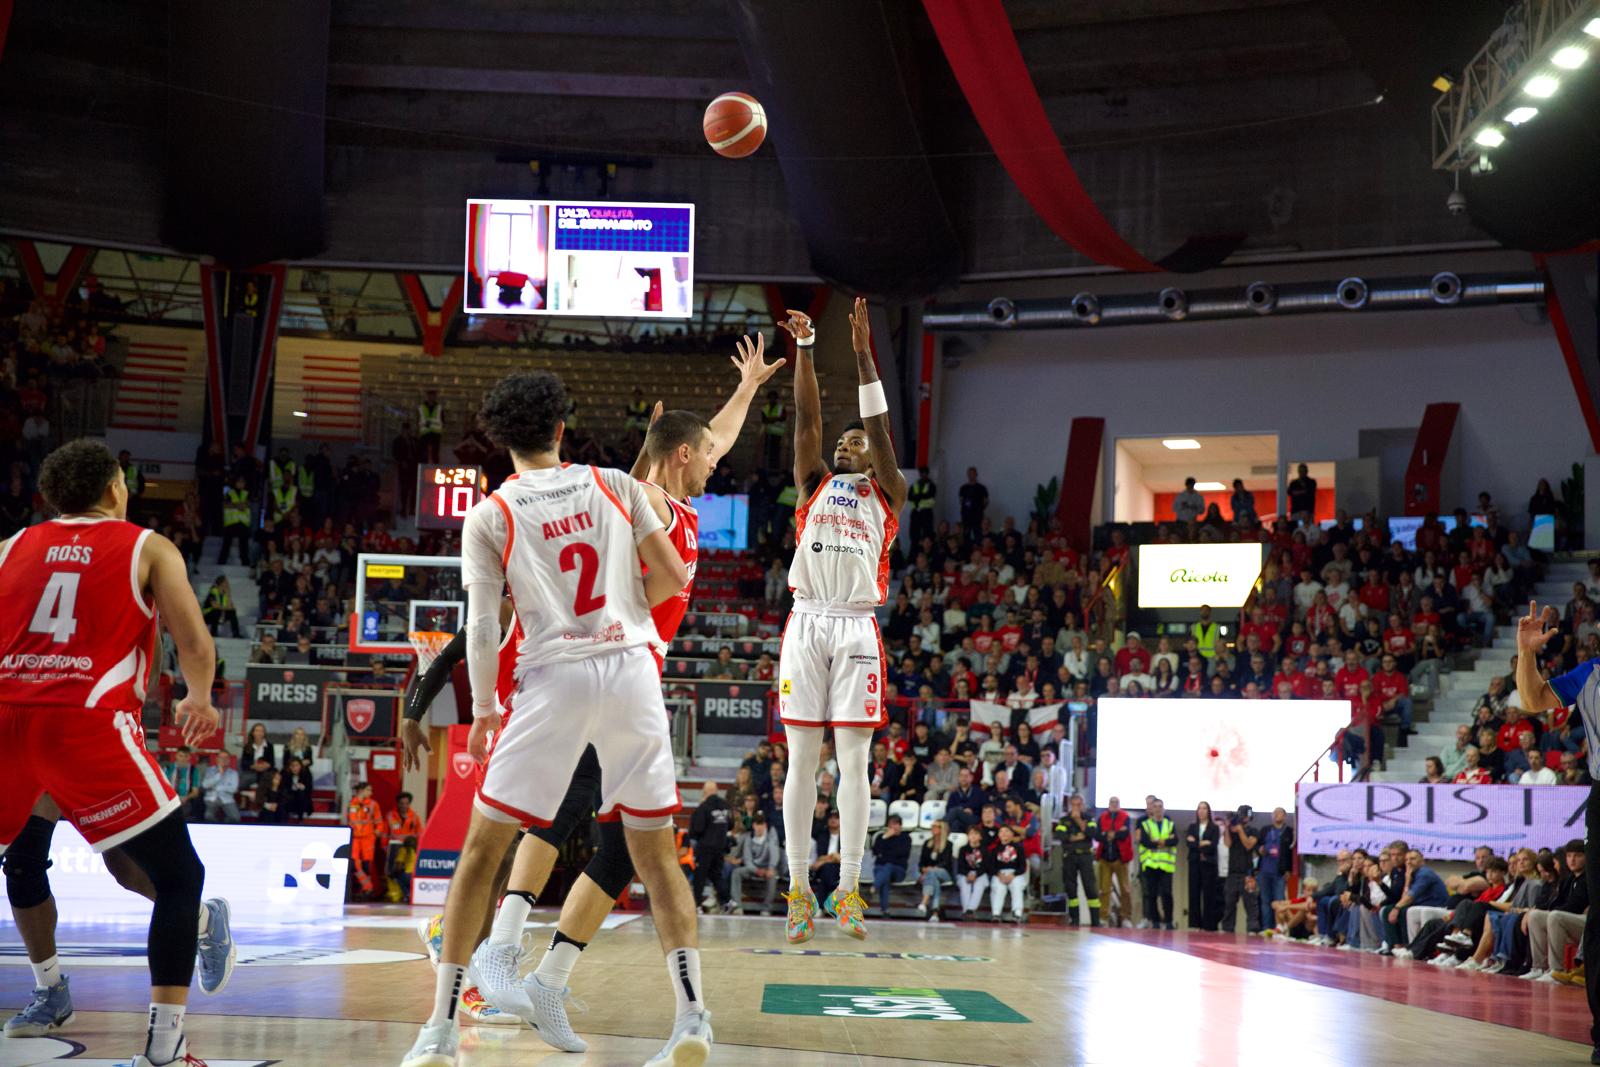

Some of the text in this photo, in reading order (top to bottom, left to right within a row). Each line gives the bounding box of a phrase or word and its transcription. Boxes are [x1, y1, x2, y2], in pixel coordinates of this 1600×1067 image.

[435, 468, 476, 485] 6:29
[438, 486, 473, 516] 10
[827, 495, 858, 509] nexi
[542, 511, 593, 541] ALVITI
[45, 545, 93, 565] ROSS
[825, 544, 864, 555] motorola
[559, 542, 607, 617] 2
[28, 572, 81, 643] 4
[0, 654, 93, 670] AUTOTORINO
[257, 683, 318, 703] PRESS
[867, 673, 878, 694] 3
[703, 697, 763, 718] PRESS
[79, 796, 133, 826] BLUENERGY
